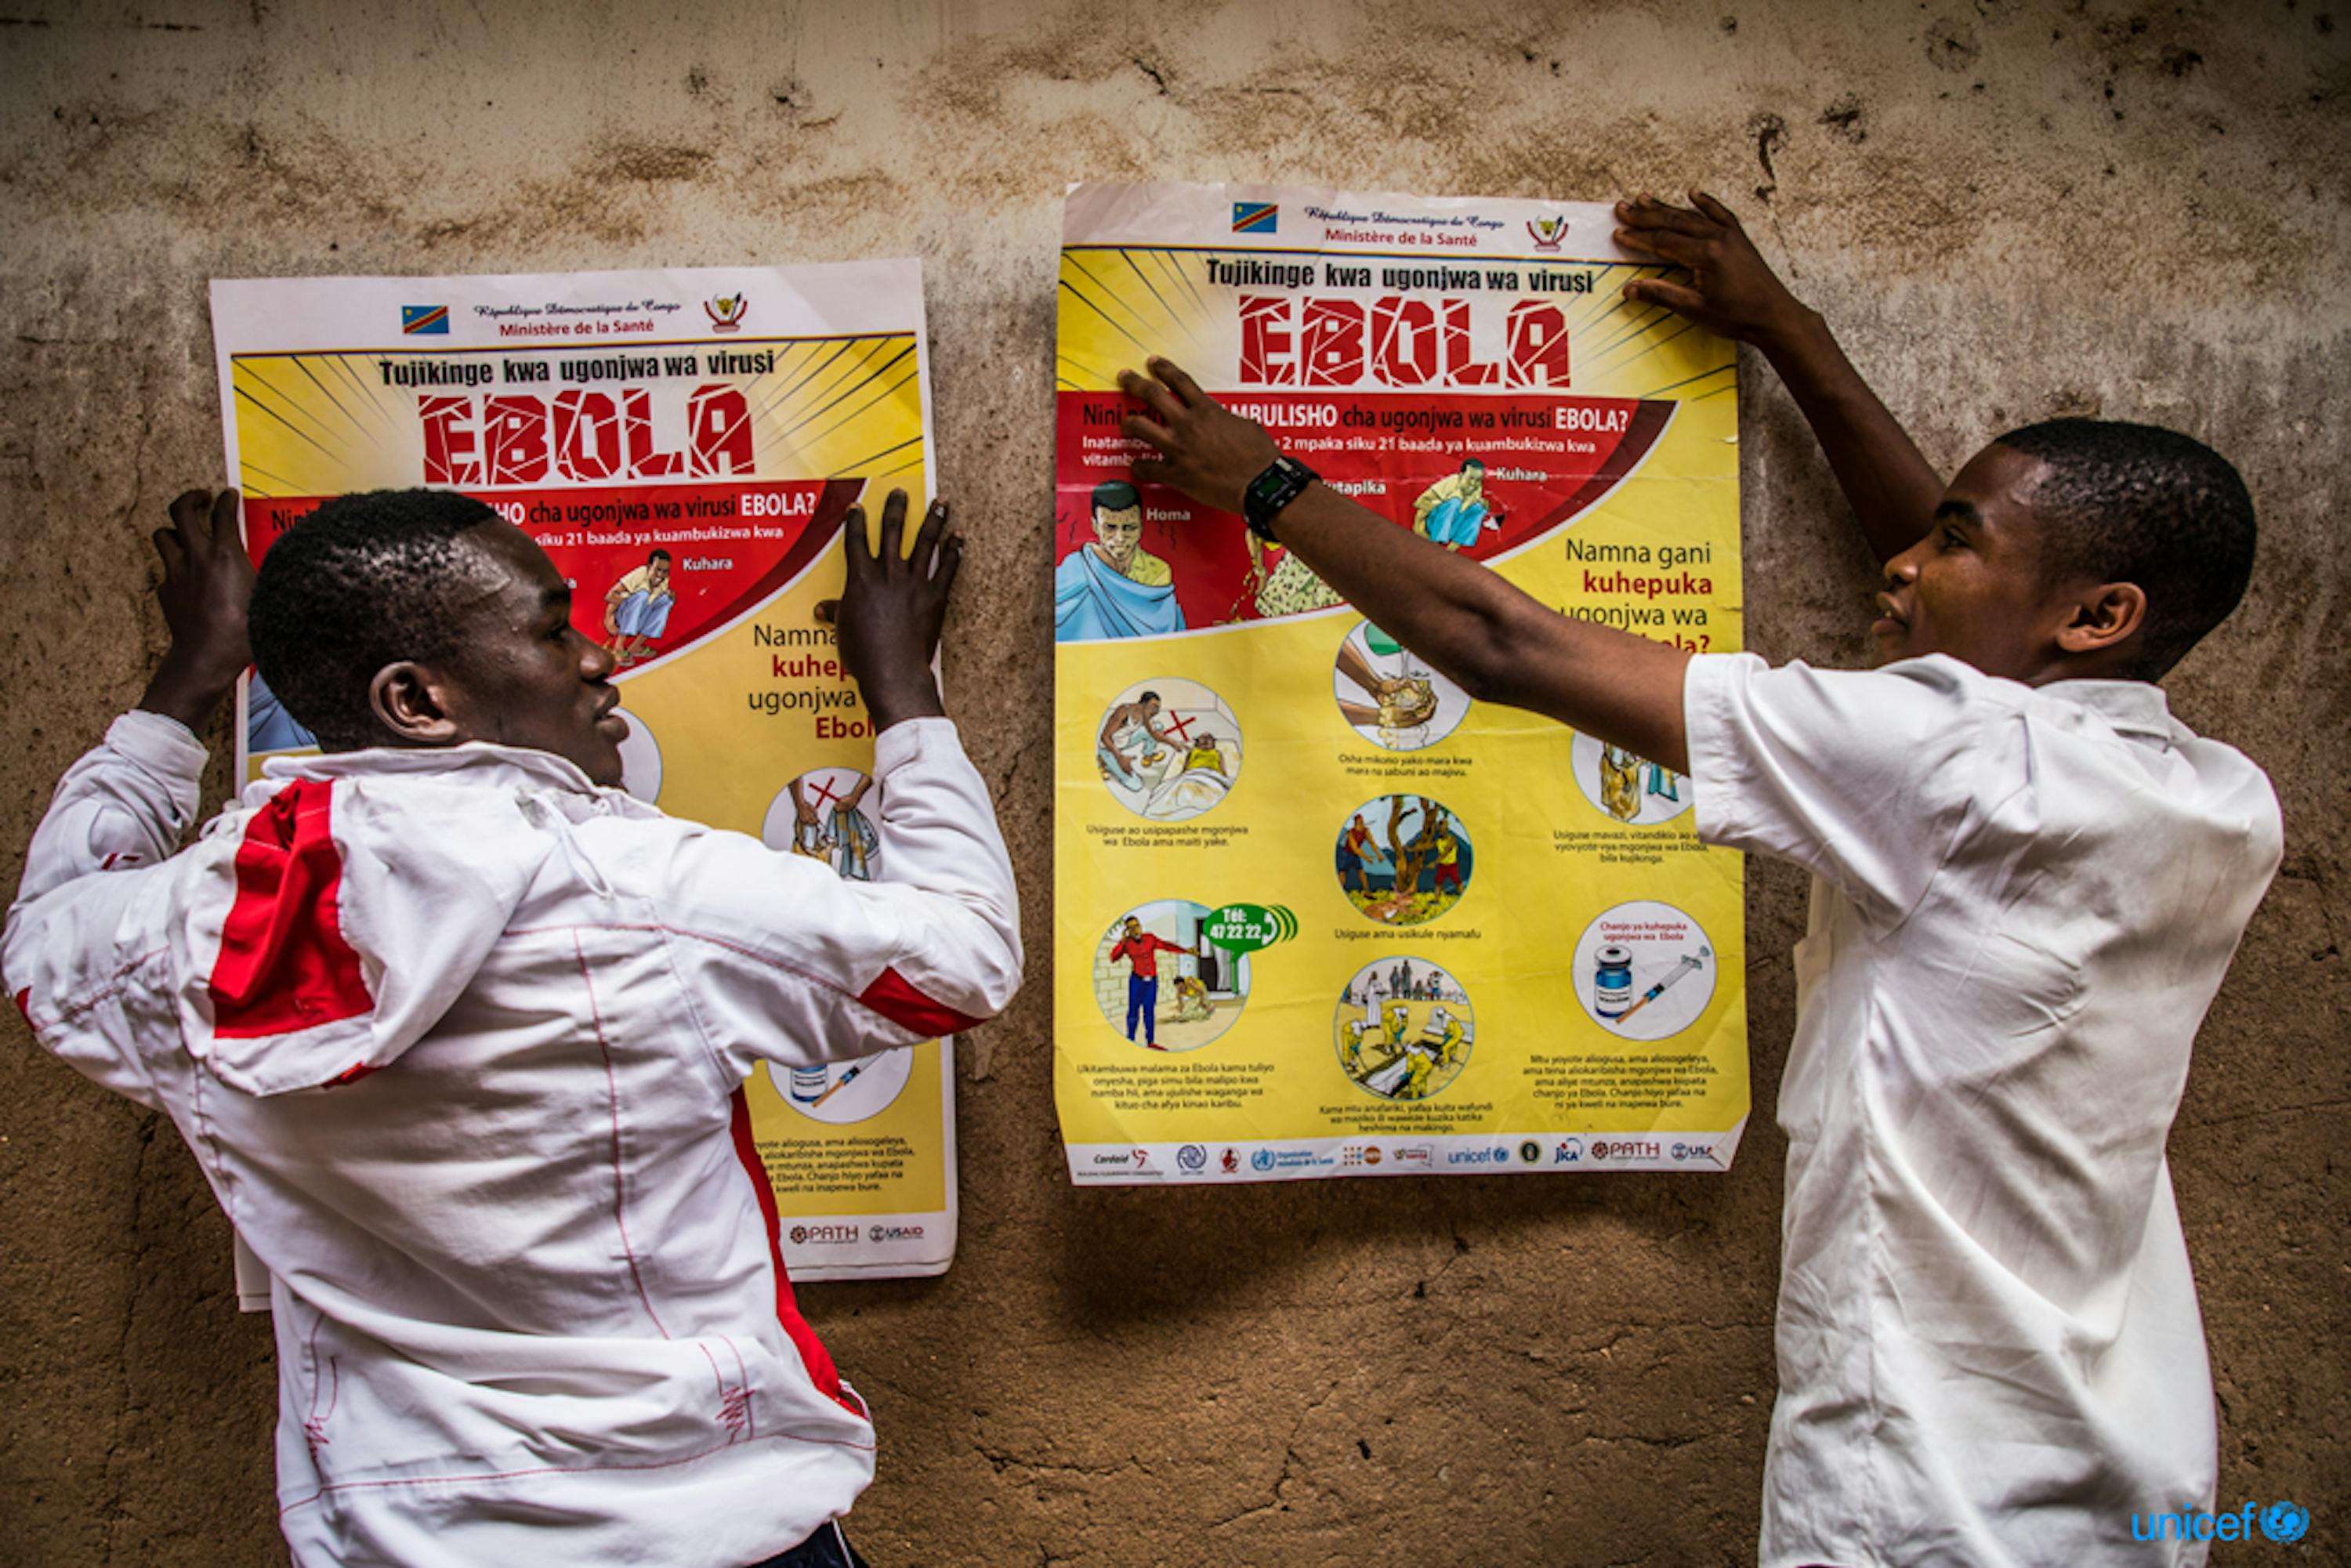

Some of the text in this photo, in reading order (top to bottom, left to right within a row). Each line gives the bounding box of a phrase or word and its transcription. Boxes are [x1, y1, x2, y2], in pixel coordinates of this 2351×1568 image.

[1305, 206, 1367, 224] République
[1450, 216, 1463, 226] du
[1466, 215, 1505, 230] Congo
[1326, 228, 1477, 247] Ministère de la Santé
[1208, 259, 1594, 295] Tujikinge kwa ugonjwa wa virusi
[473, 305, 542, 320] République
[625, 301, 639, 311] du
[642, 299, 681, 313] Congo
[500, 319, 654, 336] Ministère de la Santé
[1238, 295, 1570, 389] EBOLA
[379, 349, 775, 386] Tujikinge kwa ugonjwa wa virusi
[1084, 403, 1122, 426] Nini
[1342, 405, 1375, 428] cha
[1381, 406, 1465, 433] ugonjwa
[1469, 410, 1495, 428] wa
[1502, 406, 1552, 428] virusi
[1556, 407, 1629, 432] EBOLA?
[418, 383, 756, 486] EBOLA
[1282, 436, 1291, 450] 2
[1295, 436, 1343, 452] mpaka
[1346, 436, 1376, 450] siku
[1379, 436, 1395, 451] 21
[1398, 436, 1444, 452] baada
[1446, 440, 1463, 455] ya
[1466, 437, 1565, 453] kuambukizwa
[1568, 439, 1596, 453] kwa
[1495, 467, 1547, 483] Kuhara
[529, 502, 562, 524] cha
[567, 501, 650, 527] ugonjwa
[654, 502, 681, 520] wa
[685, 494, 736, 518] virusi
[741, 492, 816, 516] EBOLA?
[1146, 508, 1191, 521] Homa
[534, 525, 784, 547] siku 21 baada ya kuambukizwa kwa
[682, 557, 734, 571] Kuhara
[1566, 538, 1711, 570] Namna gani
[1583, 569, 1713, 599] kuhepuka
[1672, 609, 1708, 625] wa
[748, 686, 857, 715] ugonjwa
[816, 715, 873, 739] Ebol
[1122, 836, 1150, 847] Ebola
[1226, 923, 1244, 940] 22
[1245, 923, 1262, 940] 22
[1447, 1146, 1492, 1164] unicef
[1610, 1142, 1661, 1156] PATH
[809, 1226, 859, 1240] PATH
[886, 1226, 925, 1237] USAID
